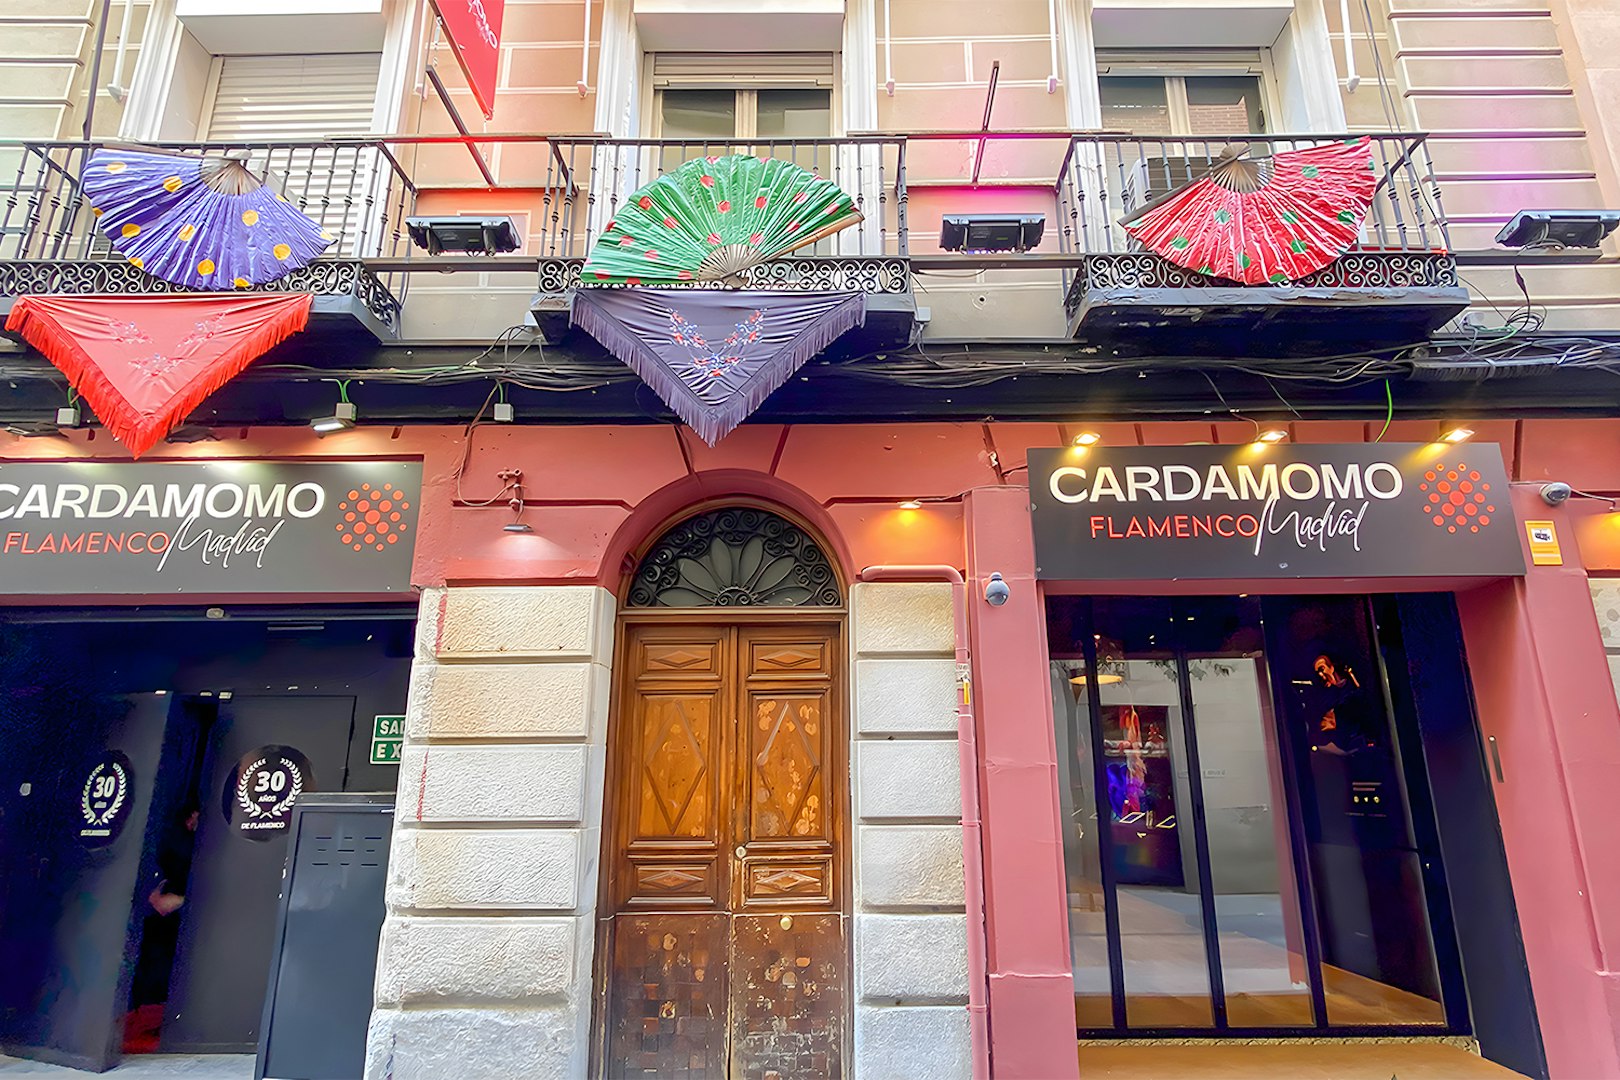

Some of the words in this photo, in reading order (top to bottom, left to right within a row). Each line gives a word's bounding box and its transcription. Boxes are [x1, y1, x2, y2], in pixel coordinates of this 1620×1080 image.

[1049, 462, 1403, 503] CARDAMOMO
[3, 532, 169, 554] FLAMENCO
[156, 515, 285, 572] Madrid
[1090, 513, 1259, 540] FLAMENCO
[1254, 495, 1370, 556] Madrid
[93, 775, 116, 798] 30
[254, 770, 286, 792] 30
